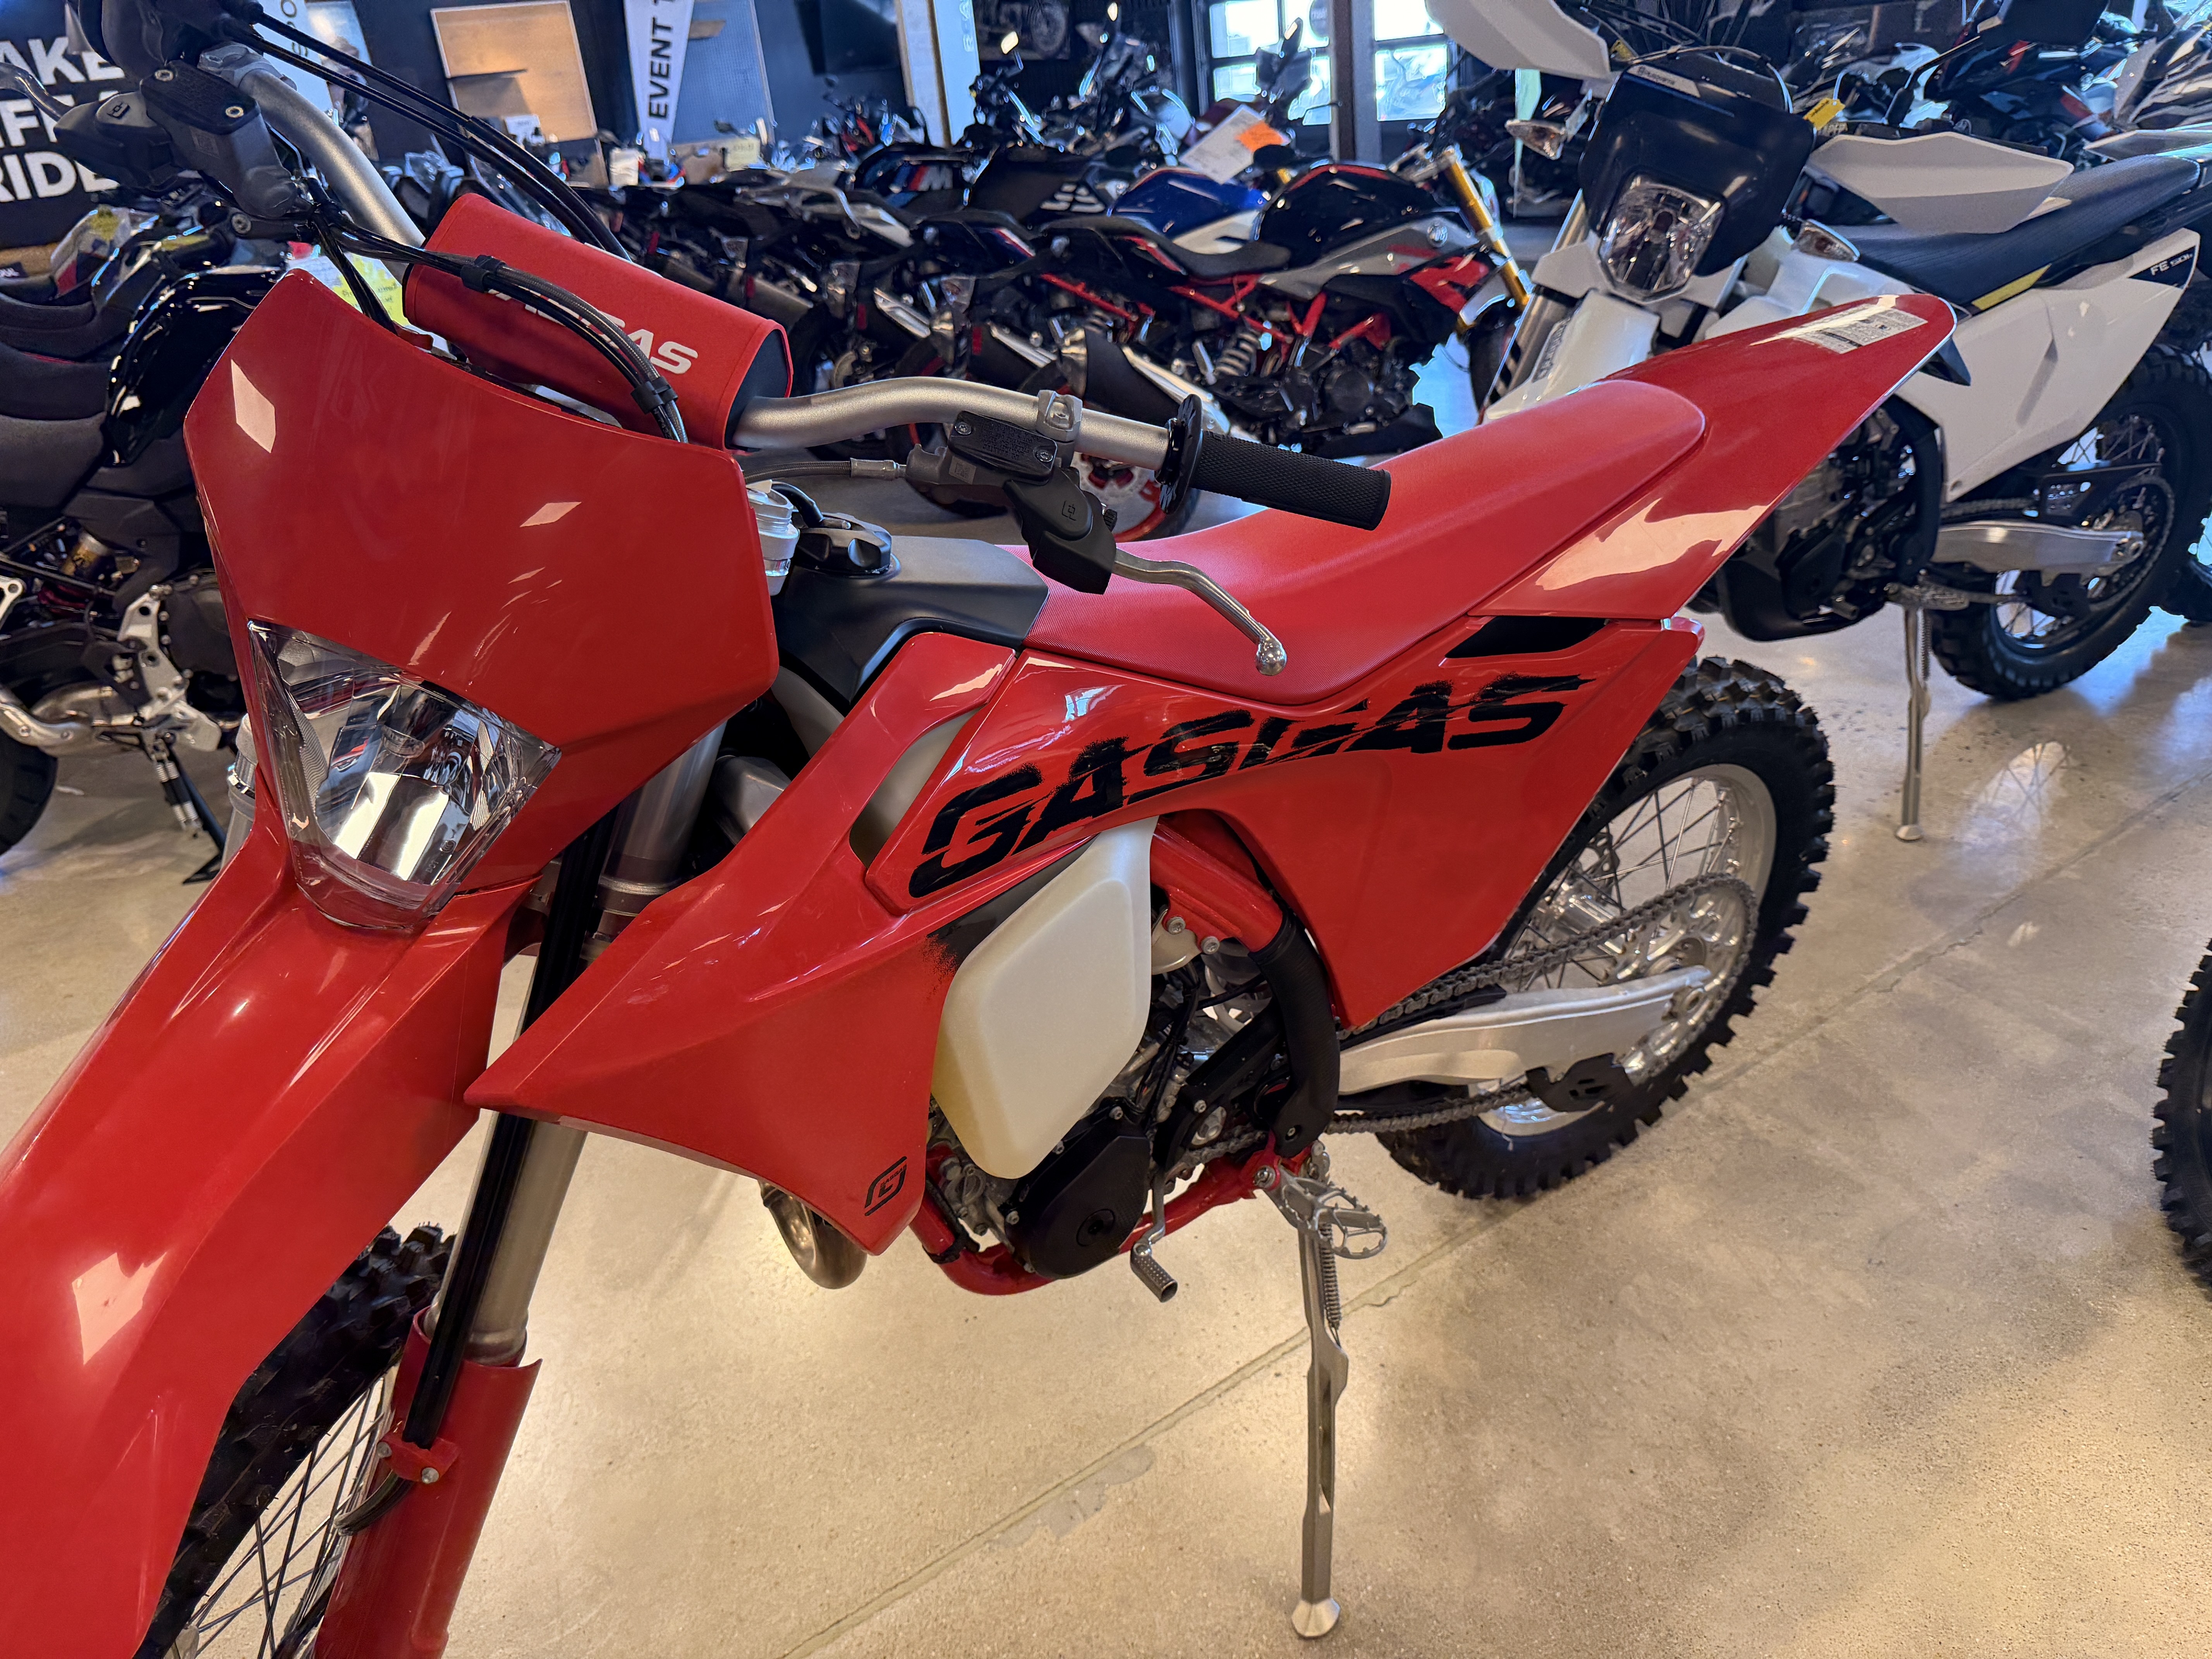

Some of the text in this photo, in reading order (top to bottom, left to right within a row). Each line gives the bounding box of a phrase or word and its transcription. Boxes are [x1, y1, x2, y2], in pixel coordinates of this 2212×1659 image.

[649, 17, 673, 118] EVENT
[2150, 261, 2169, 276] FE
[908, 672, 1596, 898] GASGAS
